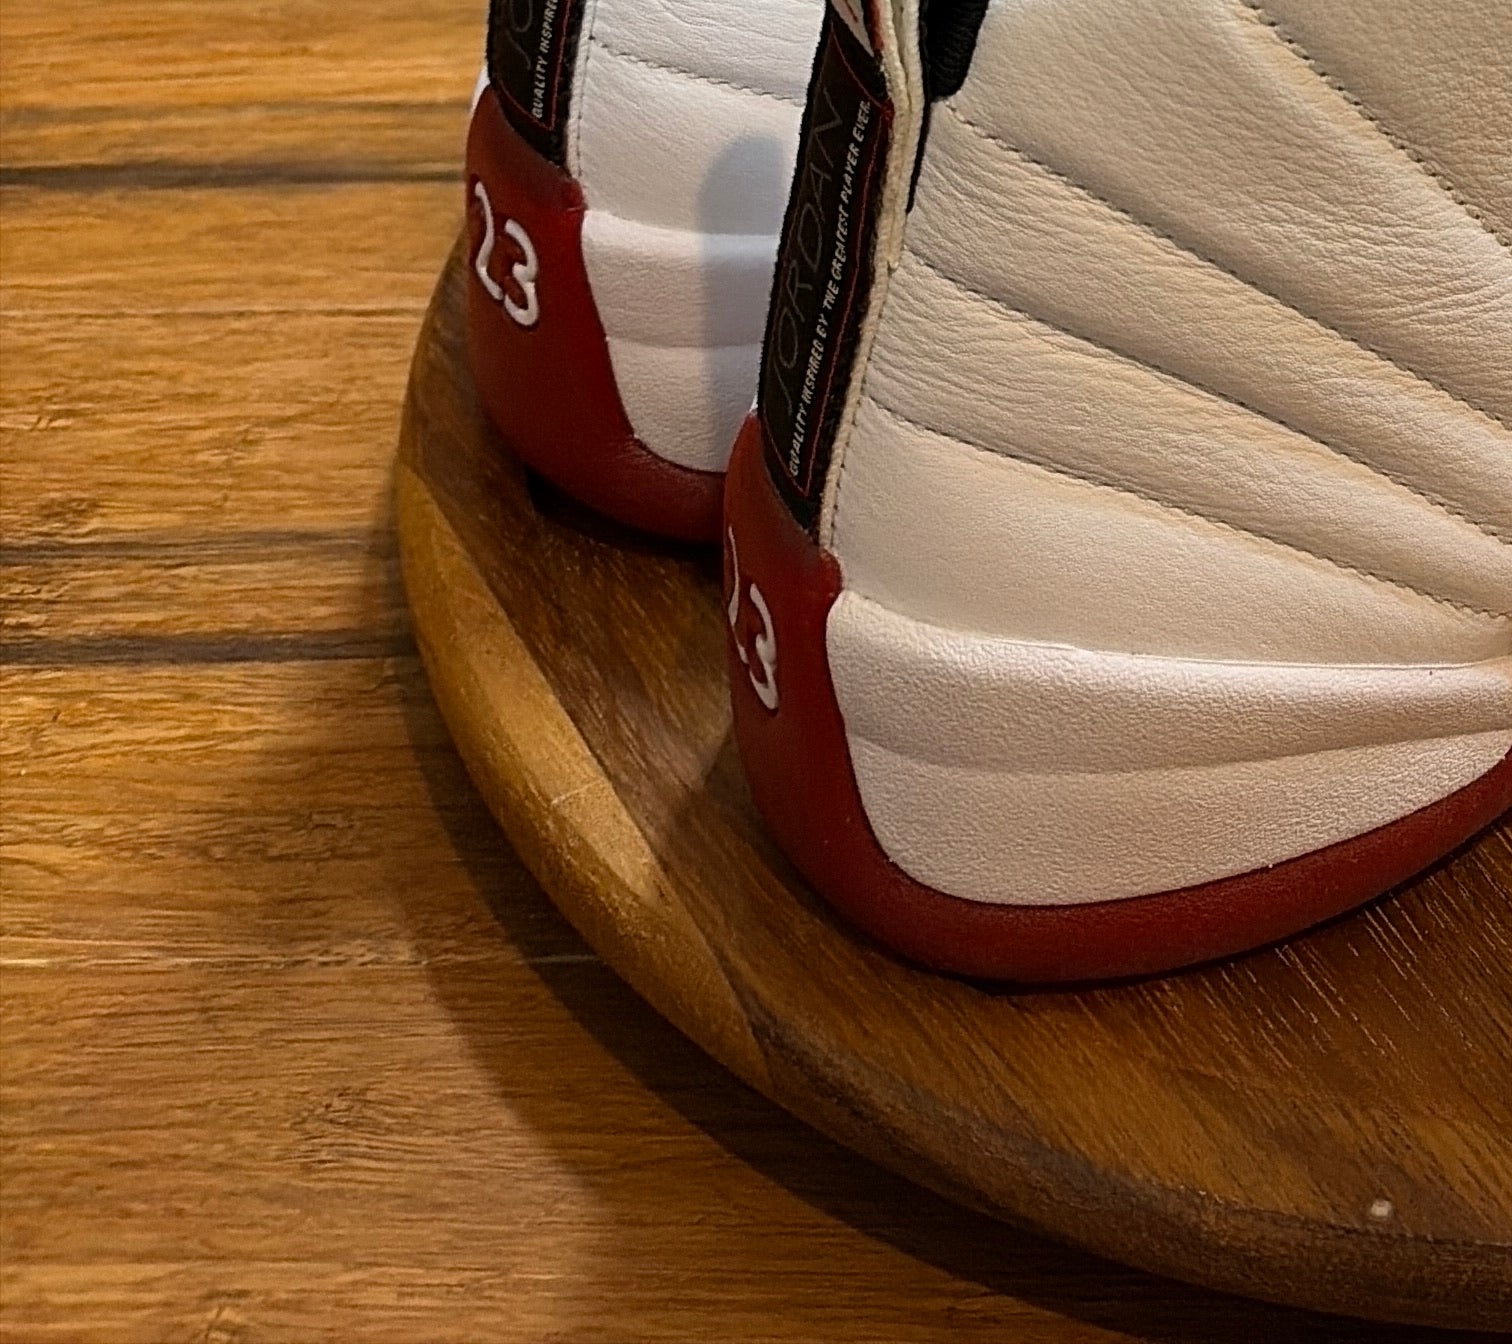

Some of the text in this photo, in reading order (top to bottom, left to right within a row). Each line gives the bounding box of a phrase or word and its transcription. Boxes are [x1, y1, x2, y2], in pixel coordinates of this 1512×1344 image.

[531, 55, 548, 119] QUALITY
[840, 144, 861, 205] PLAYER
[474, 180, 540, 327] 23
[830, 204, 849, 280] GREATEST
[822, 281, 840, 311] THE
[800, 340, 826, 405] INSPIRED
[788, 402, 808, 477] QUALITY
